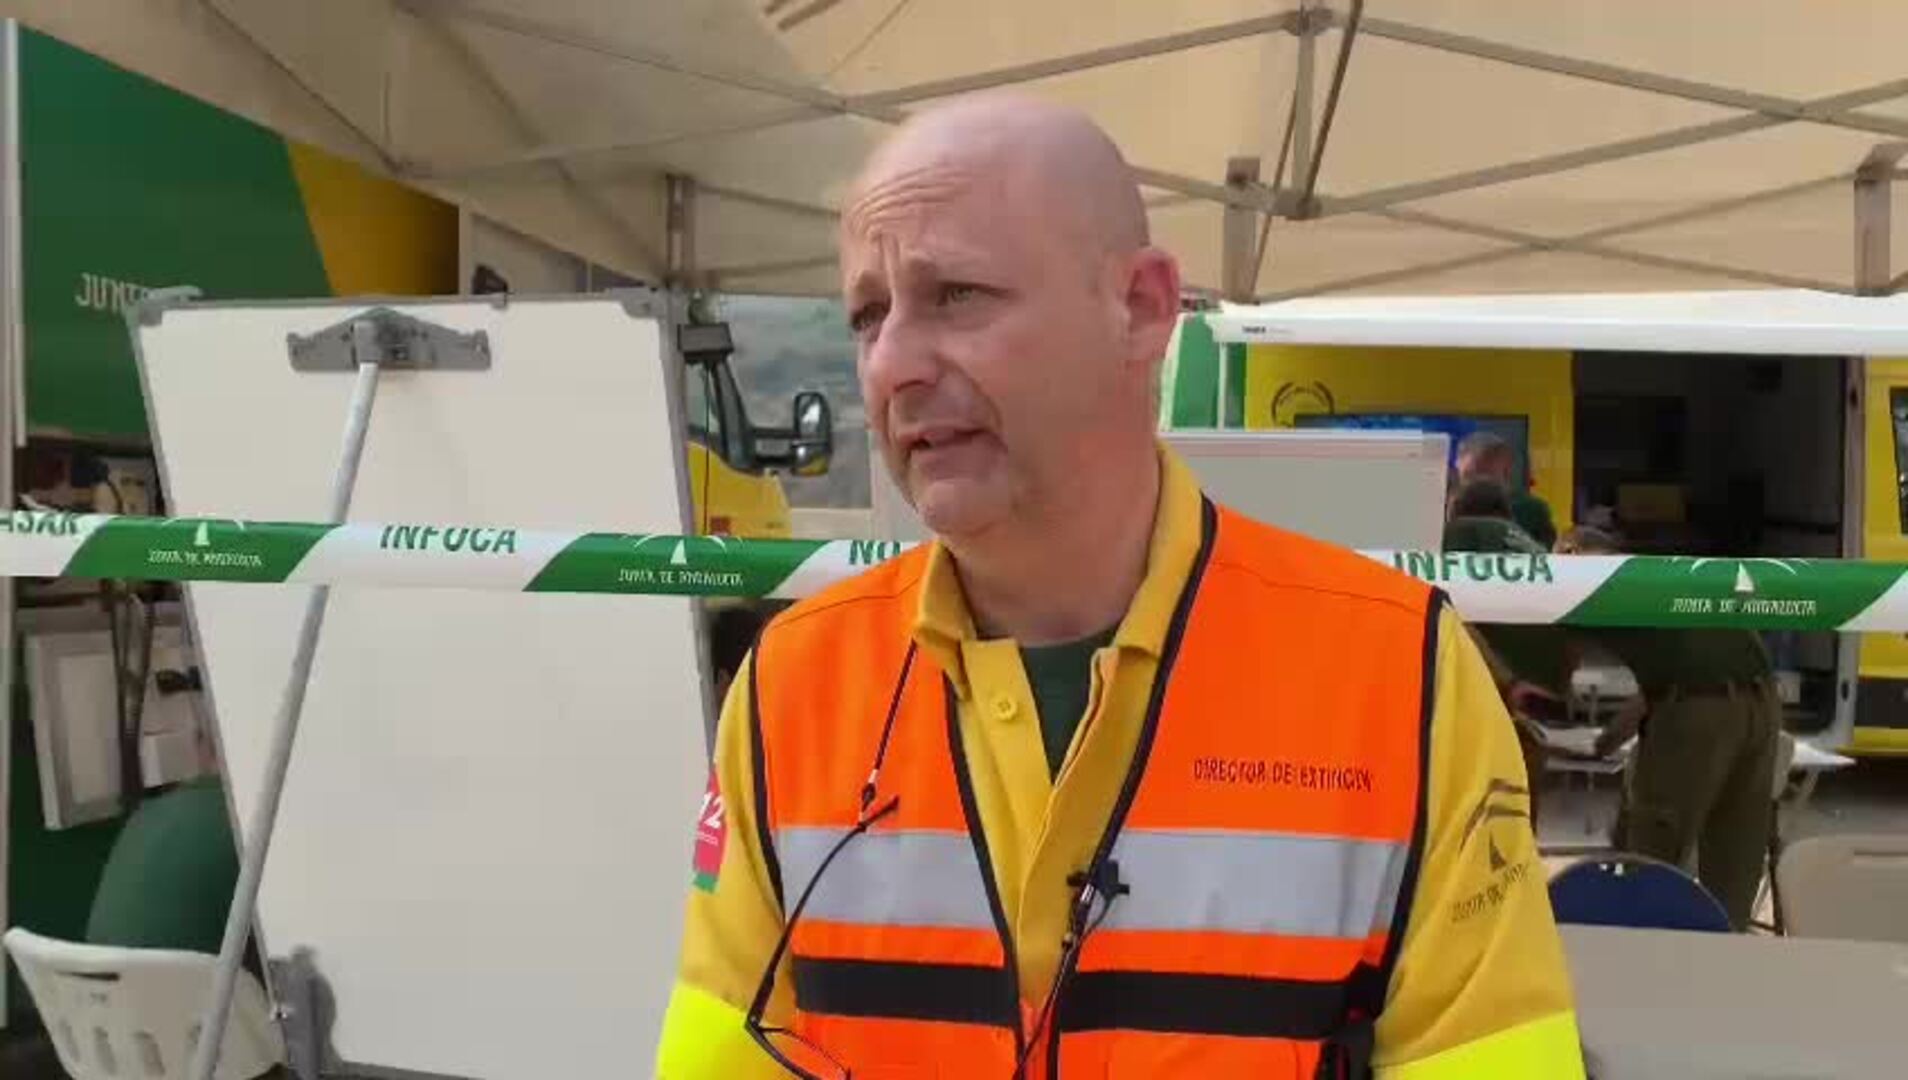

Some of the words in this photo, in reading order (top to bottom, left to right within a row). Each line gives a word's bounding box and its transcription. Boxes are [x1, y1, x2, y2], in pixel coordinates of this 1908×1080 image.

[380, 525, 516, 554] INFOCA
[1393, 550, 1553, 584] INFOCA
[1194, 758, 1266, 784] DIRECTOR
[1273, 761, 1293, 785] DE
